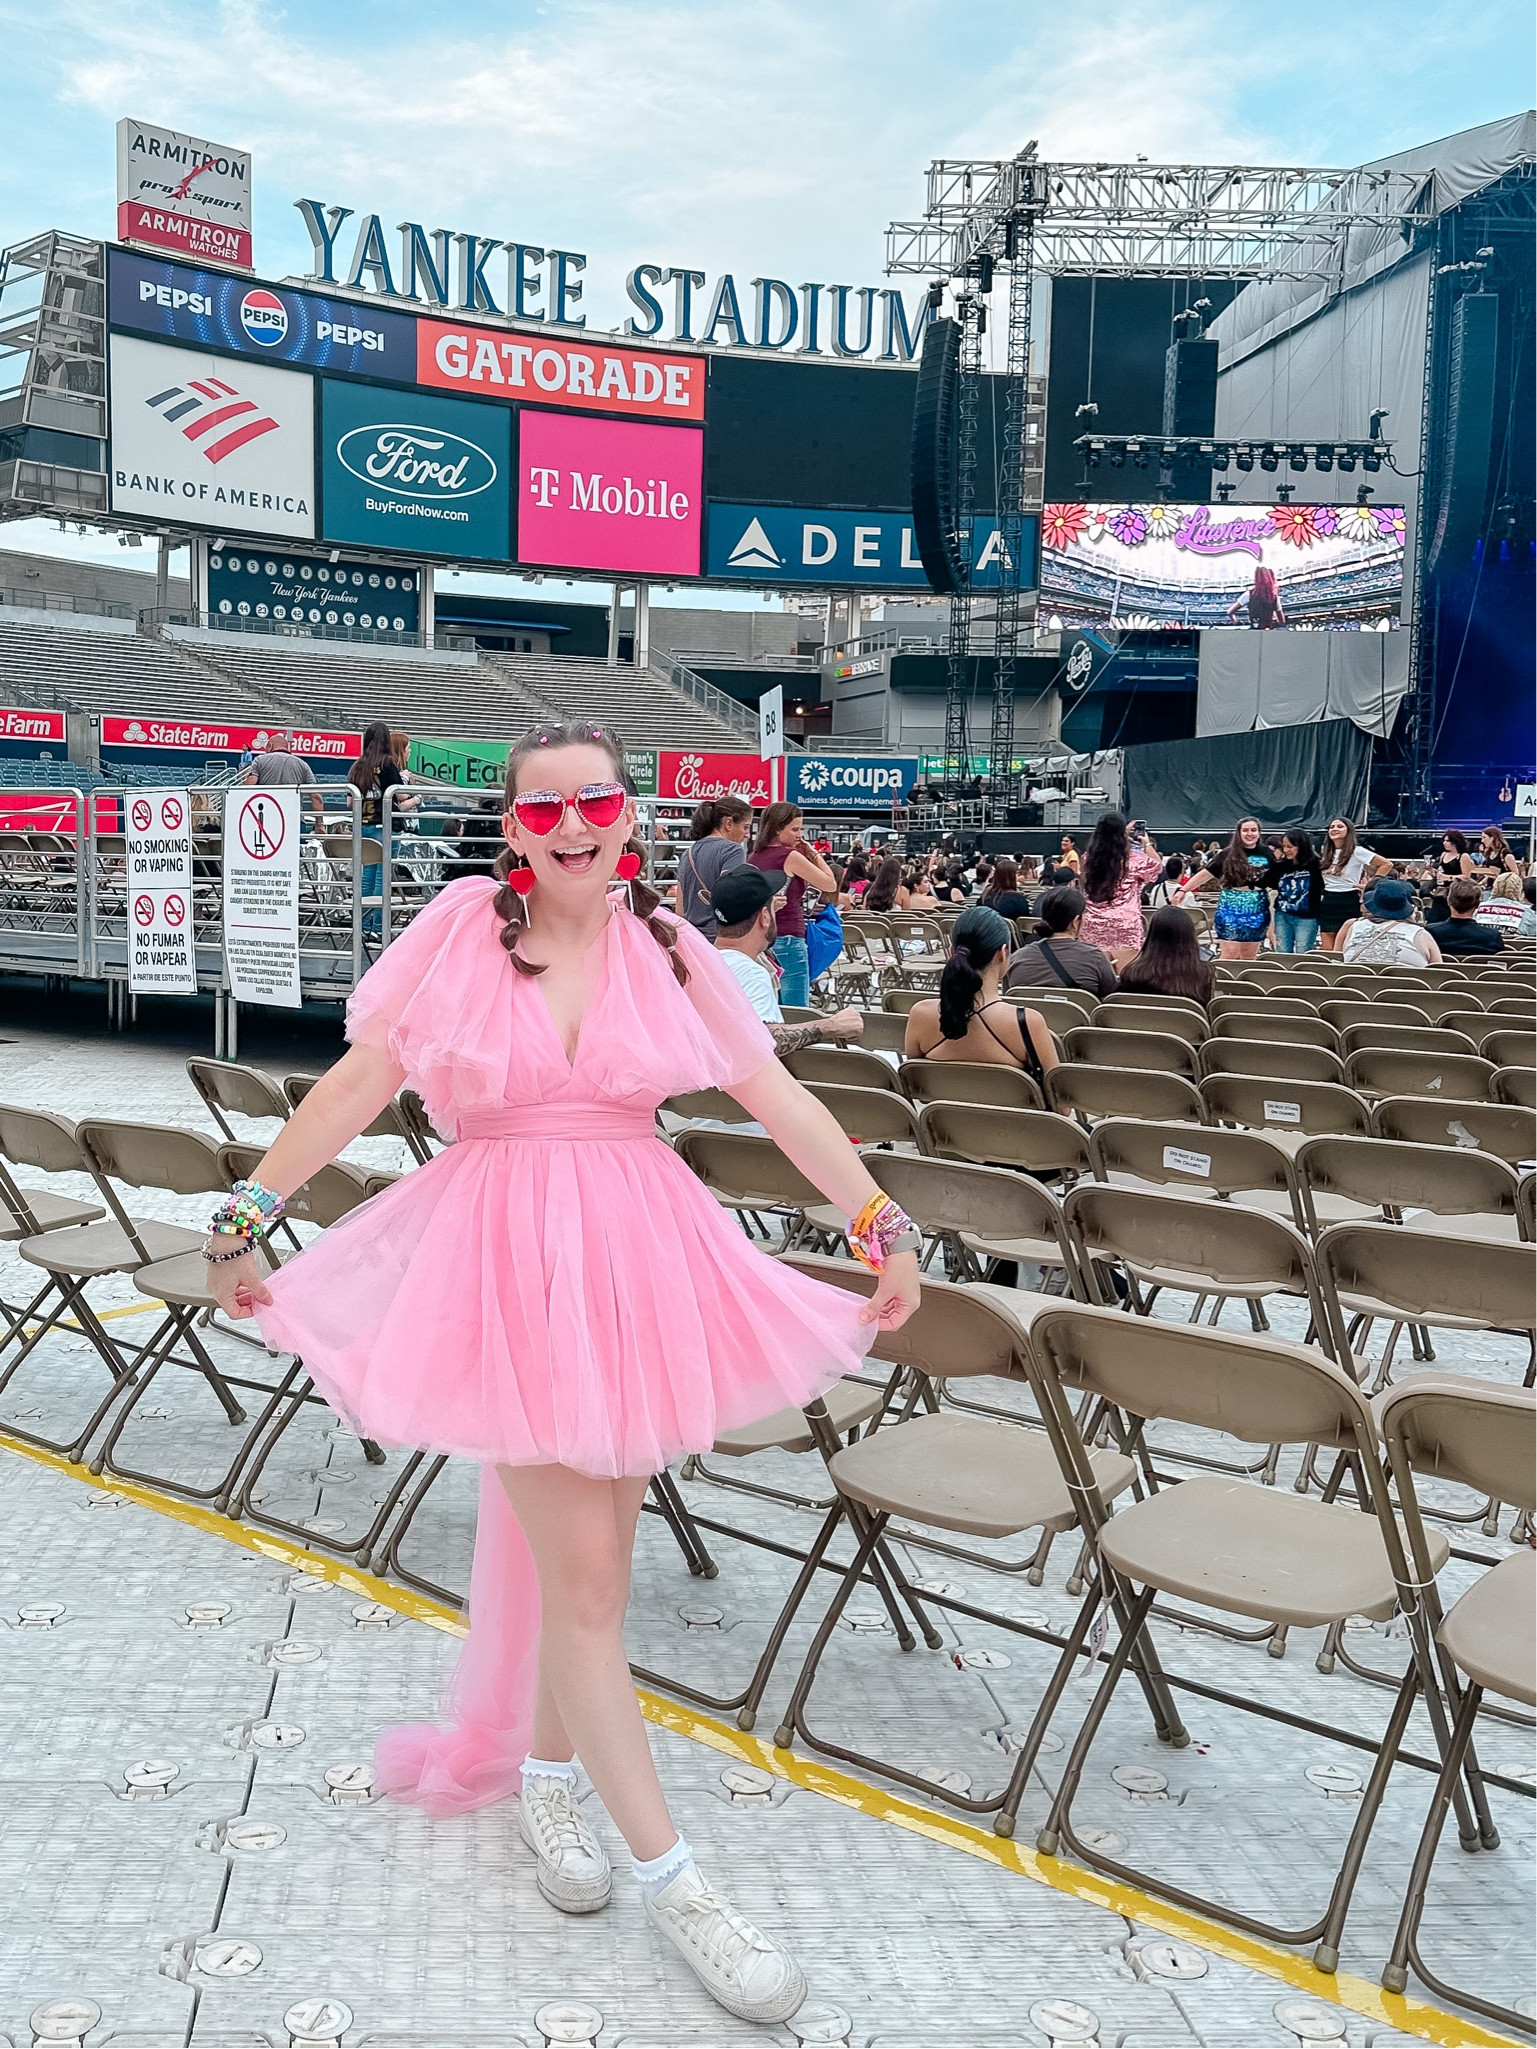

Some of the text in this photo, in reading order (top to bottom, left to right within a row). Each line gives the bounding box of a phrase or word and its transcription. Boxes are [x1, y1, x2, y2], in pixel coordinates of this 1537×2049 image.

[132, 134, 246, 182] ARMITRON
[139, 178, 241, 211] pro sport
[138, 211, 240, 249] ARMITRON
[189, 238, 239, 260] WATCHES
[293, 198, 937, 361] YANKEE STADIUM
[139, 280, 212, 316] PEPSI
[243, 307, 286, 329] PEPSI
[316, 320, 385, 352] PEPSI
[435, 334, 691, 407] GATORADE
[366, 431, 471, 490] Ford
[115, 470, 309, 516] BANK OF AMERICA
[530, 467, 690, 521] T Mobile
[365, 497, 469, 522] BuyFordNow.com
[802, 523, 1013, 571] DELA
[270, 581, 359, 606] New York Yankees
[765, 710, 776, 736] B8
[624, 751, 654, 765] kmen's
[629, 764, 653, 778] Circle
[674, 763, 769, 801] Chick-fil-A
[830, 767, 903, 794] coupa
[638, 805, 649, 814] A7
[797, 795, 903, 807] Business Spend Management
[129, 838, 189, 855] NO SMOKING
[134, 858, 184, 873] OR VAPING
[136, 932, 185, 948] NO FUMAR
[135, 952, 187, 966] OR VAPEAR
[161, 974, 174, 982] ESTE
